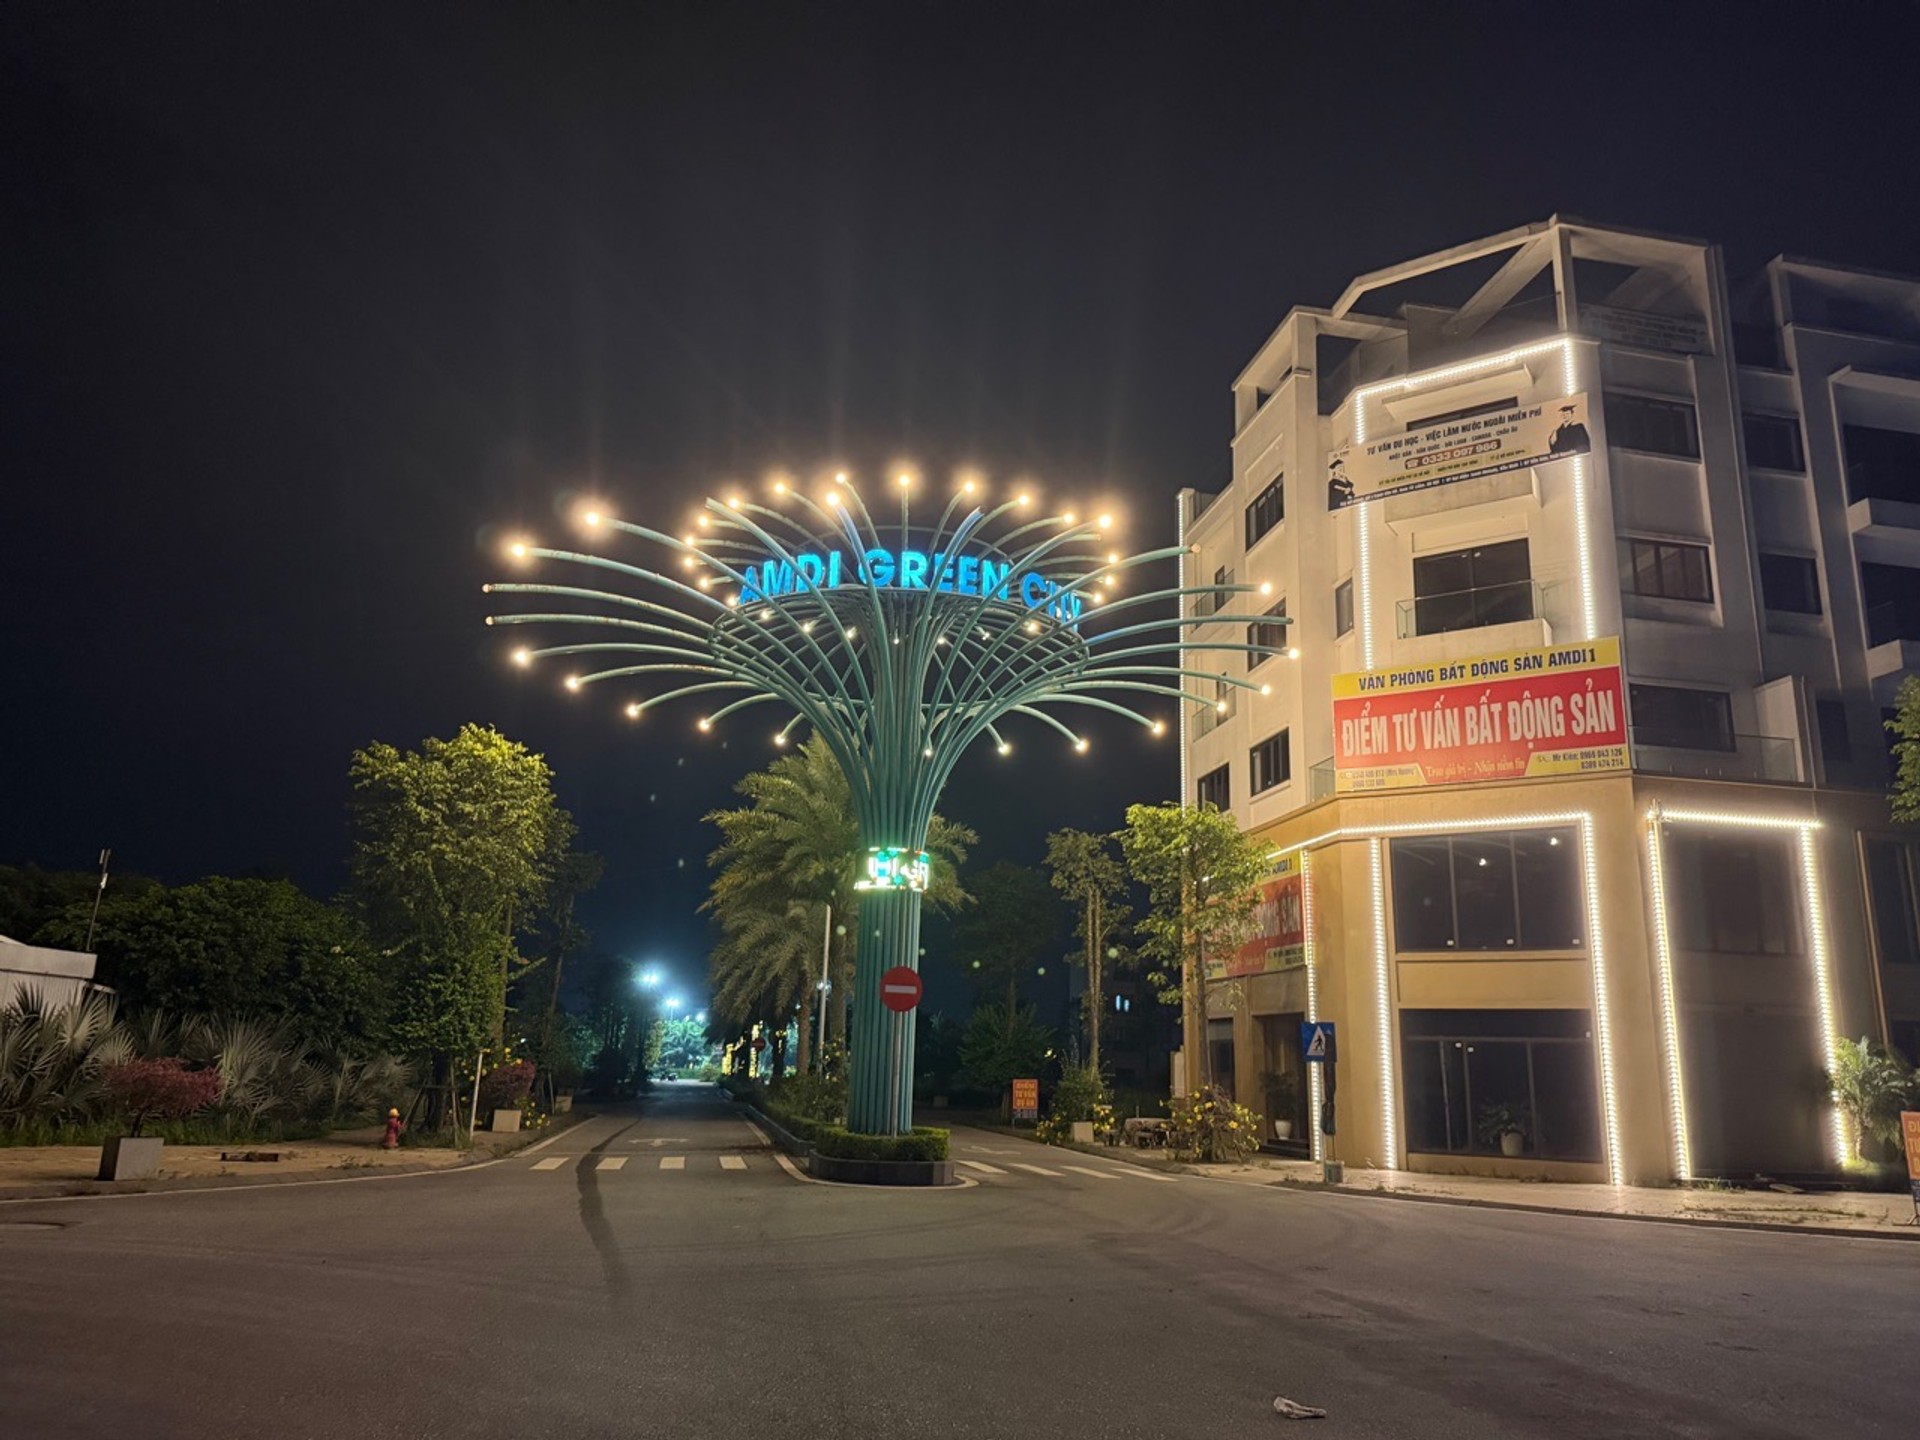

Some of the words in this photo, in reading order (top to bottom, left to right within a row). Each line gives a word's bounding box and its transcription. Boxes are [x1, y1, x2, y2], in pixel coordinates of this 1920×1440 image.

[739, 550, 841, 604] AMDI
[858, 549, 1009, 600] GREEN
[1439, 659, 1466, 681] BẤT
[1471, 659, 1509, 681] ĐỘNG
[1341, 702, 1389, 757] ĐIỂM
[1392, 709, 1417, 752] TƯ
[1419, 694, 1461, 750] VẤN
[1465, 689, 1502, 746] BẤT
[1507, 690, 1563, 749] ĐỘNG
[1570, 678, 1617, 736] SẢN
